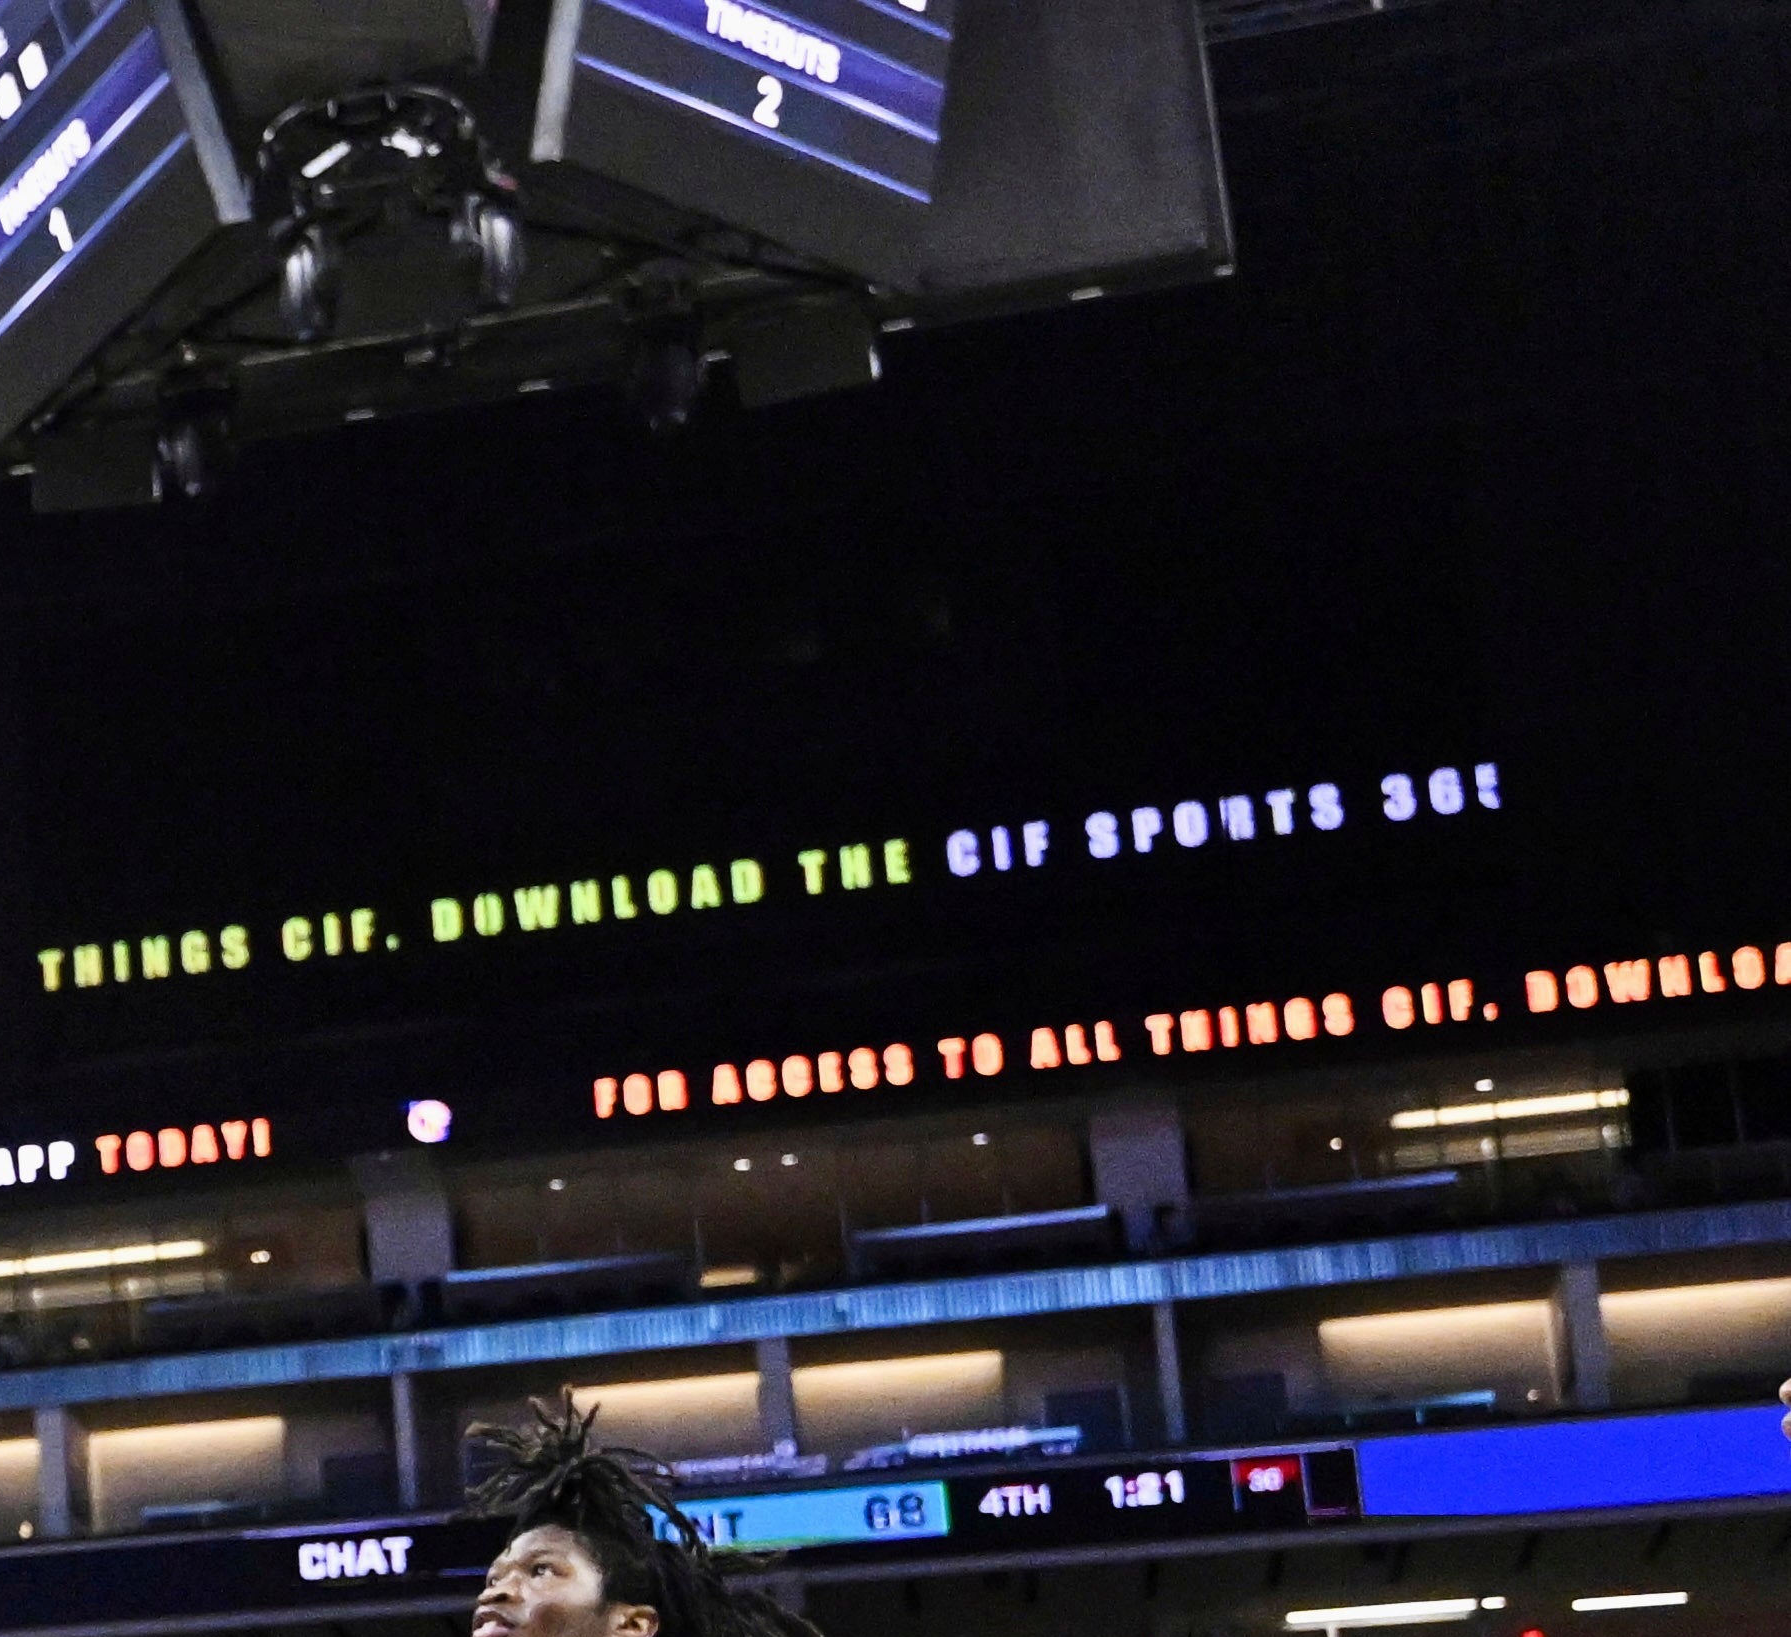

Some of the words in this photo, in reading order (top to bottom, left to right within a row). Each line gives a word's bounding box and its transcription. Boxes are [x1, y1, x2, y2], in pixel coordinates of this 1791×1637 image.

[705, 0, 841, 83] TIMEOUTS
[752, 75, 783, 129] 2
[49, 207, 73, 251] 1
[37, 925, 250, 992] THINGS
[430, 858, 763, 943] DOWNLOAD
[797, 838, 911, 895] THE
[946, 820, 1050, 878] CIF
[1084, 782, 1345, 859] SPORTS
[593, 1069, 689, 1119] FOR
[711, 1043, 914, 1105] ACCESS
[937, 1032, 1004, 1079] TO
[1030, 1020, 1121, 1070] ALL
[1144, 992, 1355, 1056] THINGS
[1524, 941, 1791, 1013] DOWNLO
[95, 1117, 271, 1174] TODAY!
[978, 1484, 1052, 1517] 4TH
[299, 1535, 414, 1580] CHAT
